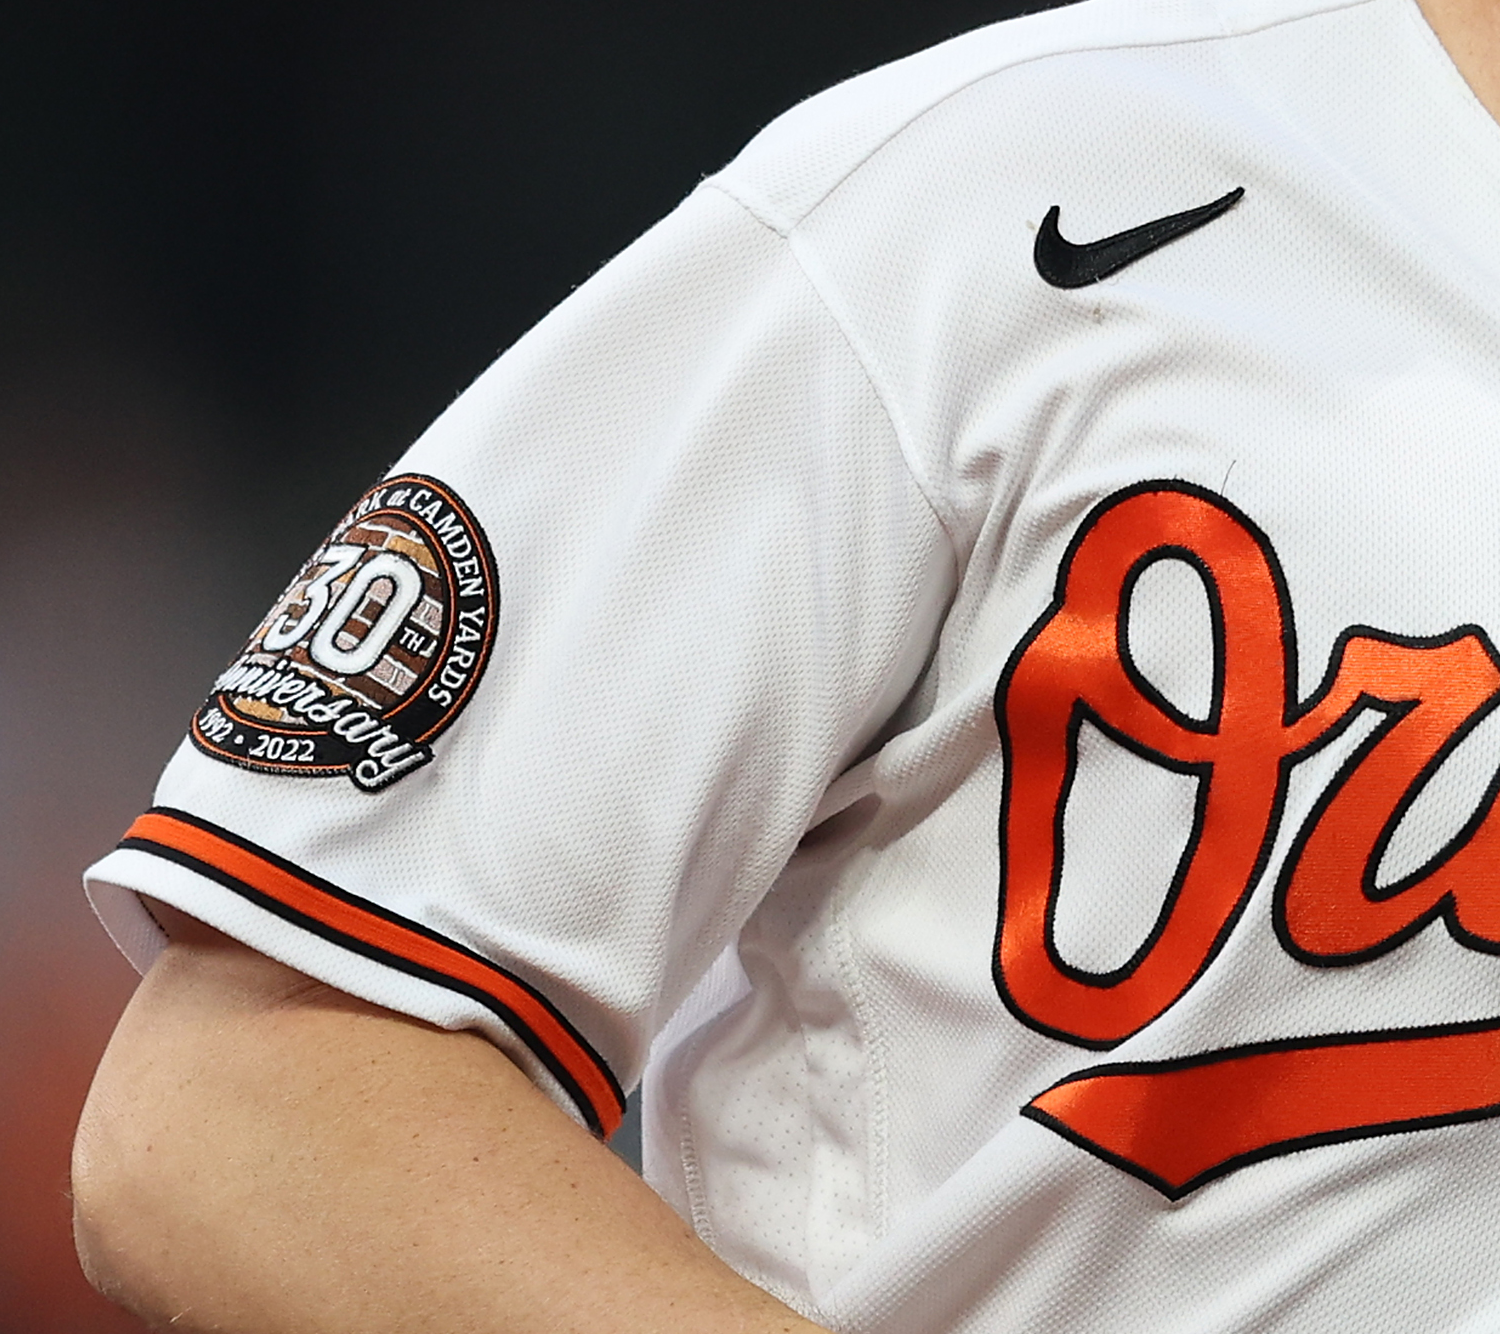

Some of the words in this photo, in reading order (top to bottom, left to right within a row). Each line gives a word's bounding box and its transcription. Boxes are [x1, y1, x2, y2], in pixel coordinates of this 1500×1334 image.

[408, 488, 485, 597] CAMDEN
[261, 543, 423, 675] 30
[428, 605, 486, 707] YARDS
[198, 708, 234, 744] 1992
[248, 734, 316, 762] 2022
